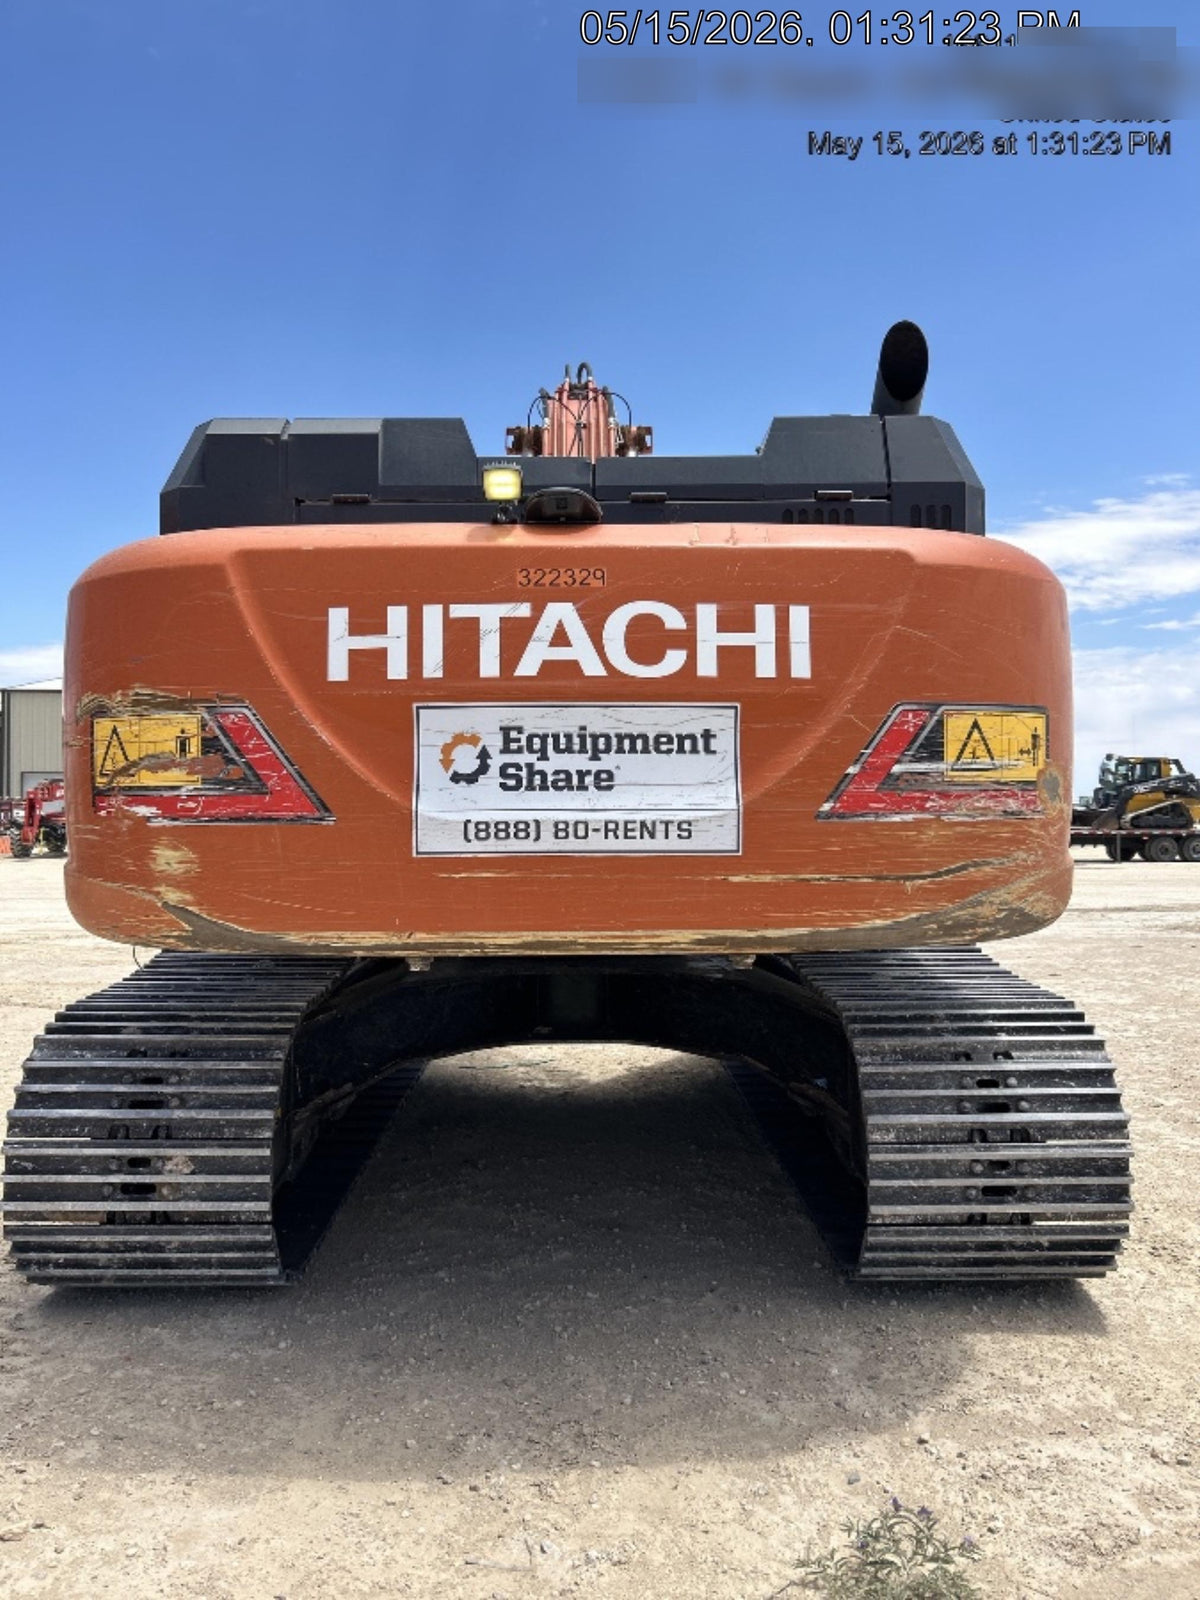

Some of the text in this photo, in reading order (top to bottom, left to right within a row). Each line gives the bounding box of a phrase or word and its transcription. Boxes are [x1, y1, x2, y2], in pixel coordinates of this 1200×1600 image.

[518, 568, 606, 587] 322329
[327, 600, 811, 682] HITACHI
[499, 725, 717, 761] Equipment
[499, 762, 615, 792] Share
[463, 819, 693, 843] (888) 80-RENTS
